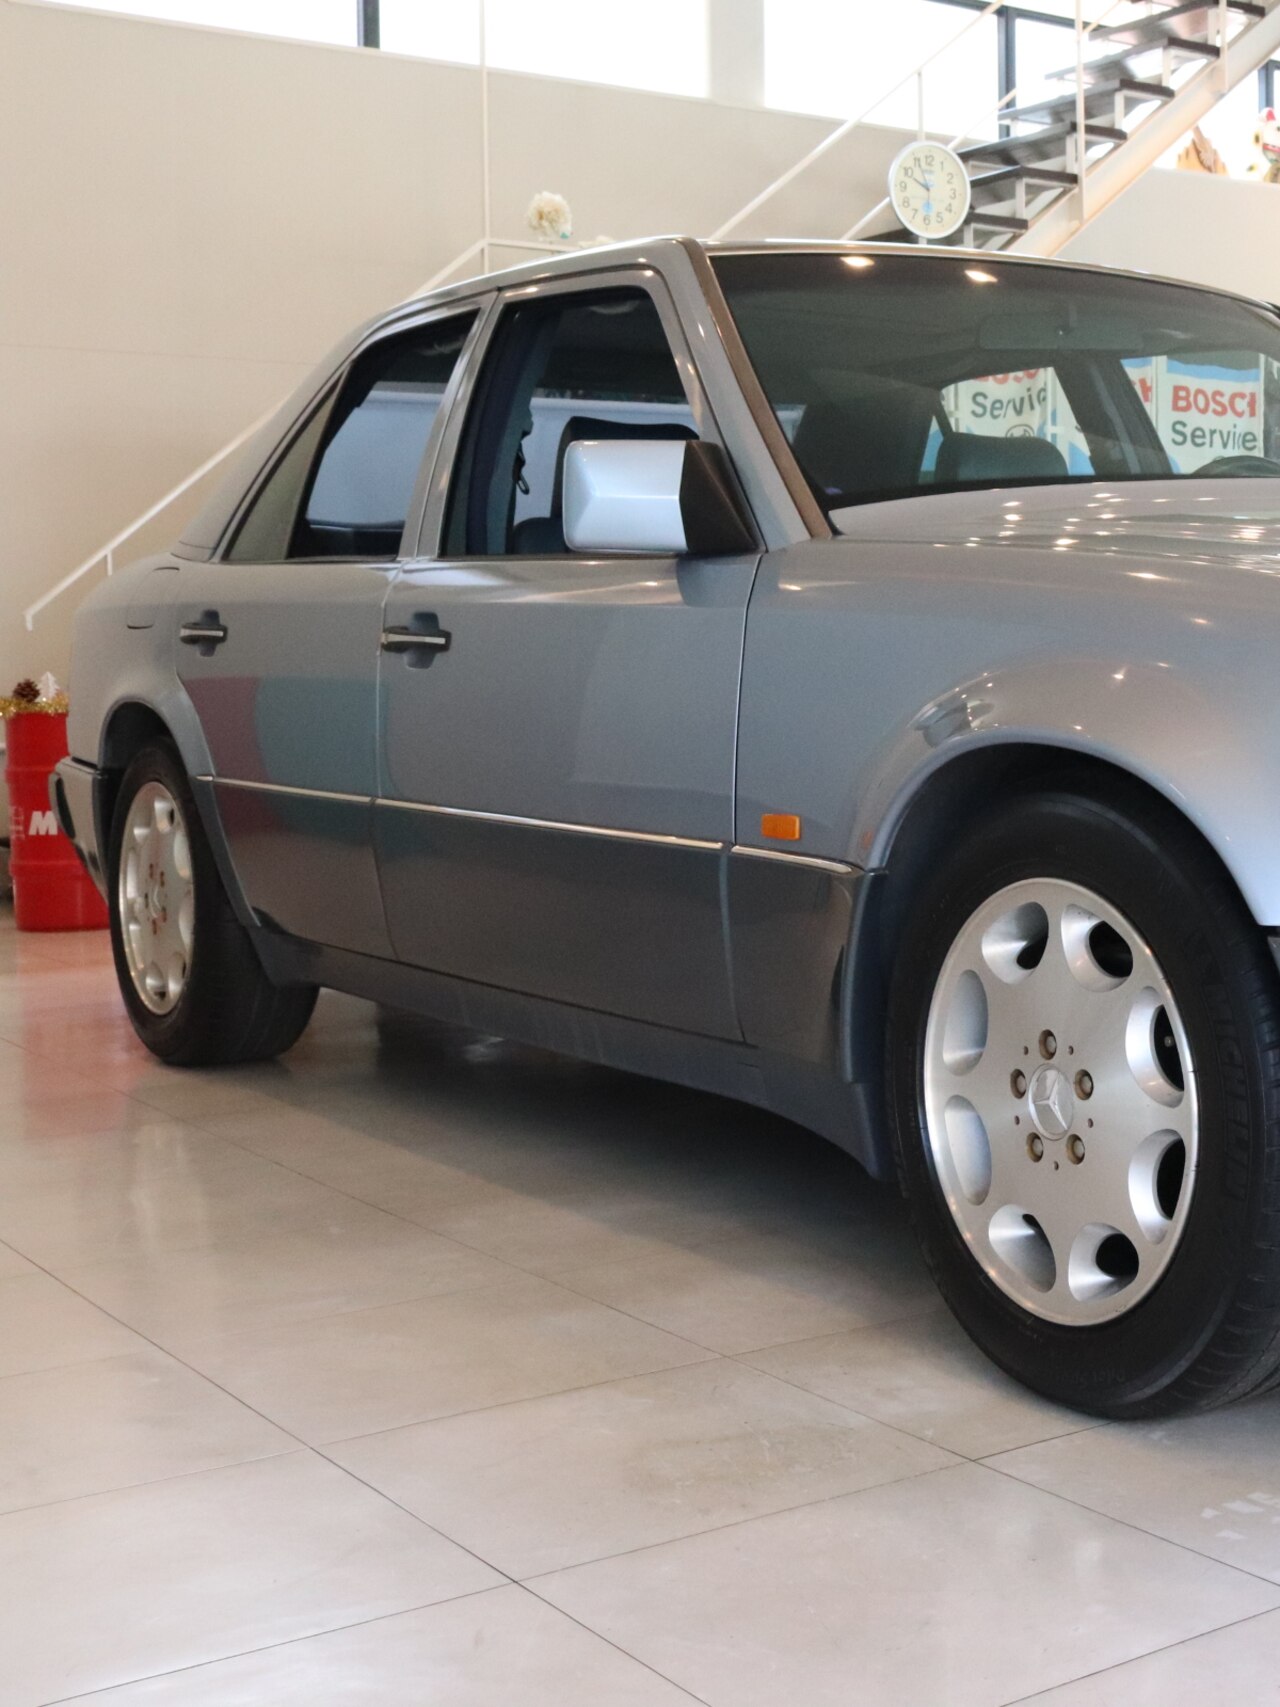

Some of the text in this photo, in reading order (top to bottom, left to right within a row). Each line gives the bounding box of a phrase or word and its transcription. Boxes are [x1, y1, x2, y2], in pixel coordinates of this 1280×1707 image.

[924, 154, 935, 167] 12
[903, 166, 914, 178] 10
[946, 172, 954, 184] 2
[899, 181, 907, 192] 9
[949, 188, 957, 200] 3
[902, 196, 910, 208] 8
[945, 202, 953, 214] 4
[911, 208, 919, 220] 7
[923, 214, 931, 226] 6
[936, 212, 944, 223] 5
[971, 385, 1047, 420] Servic
[1171, 420, 1258, 451] Service
